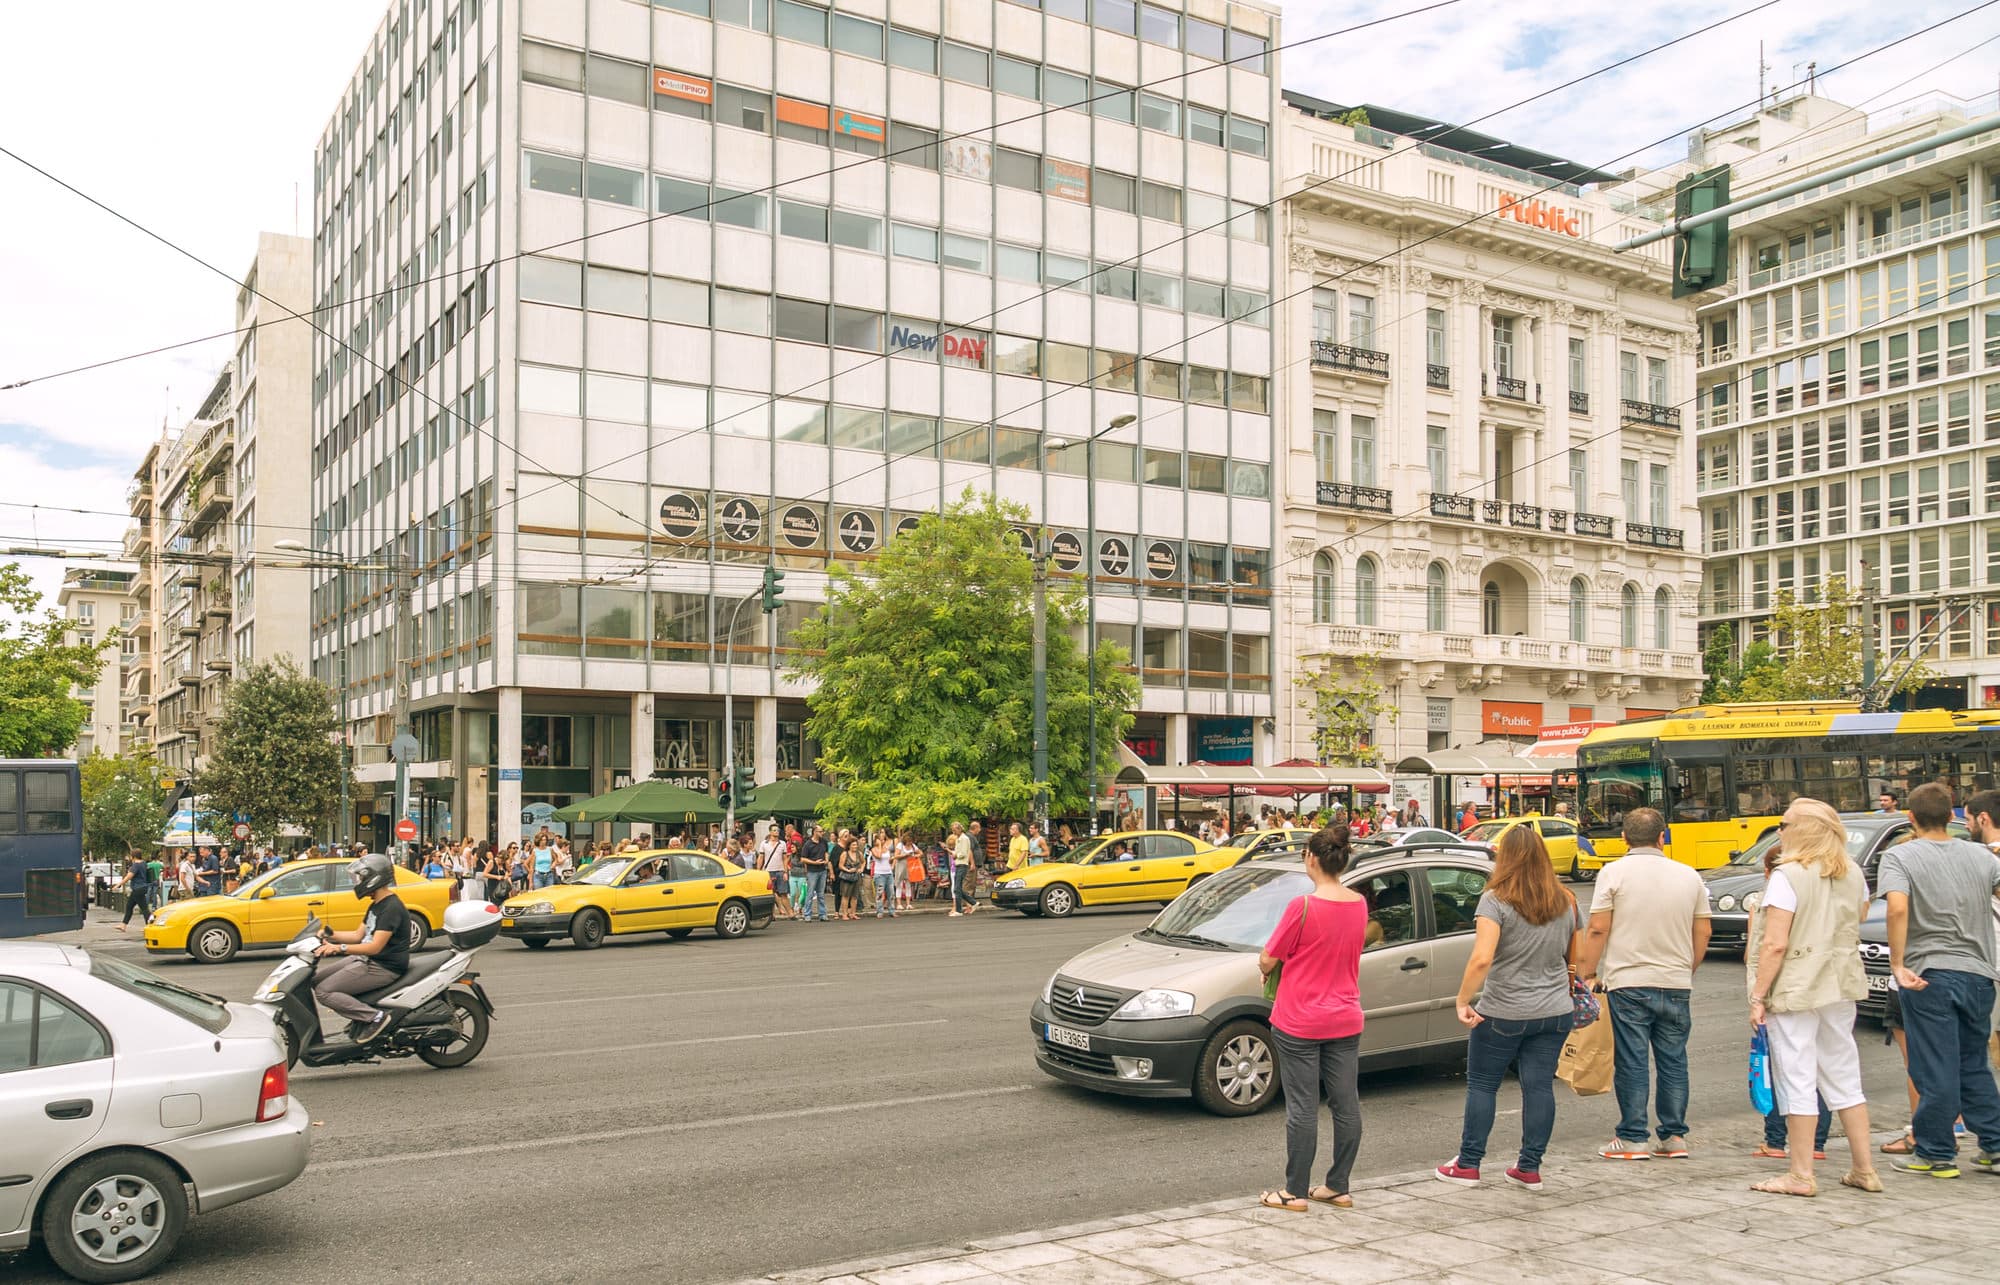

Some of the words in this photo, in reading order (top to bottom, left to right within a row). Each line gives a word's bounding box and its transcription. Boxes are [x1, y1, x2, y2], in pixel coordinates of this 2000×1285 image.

[1498, 192, 1580, 237] Public
[890, 325, 940, 353] New
[943, 334, 987, 361] DAY
[1501, 716, 1532, 727] Public
[615, 774, 709, 789] Mnald's
